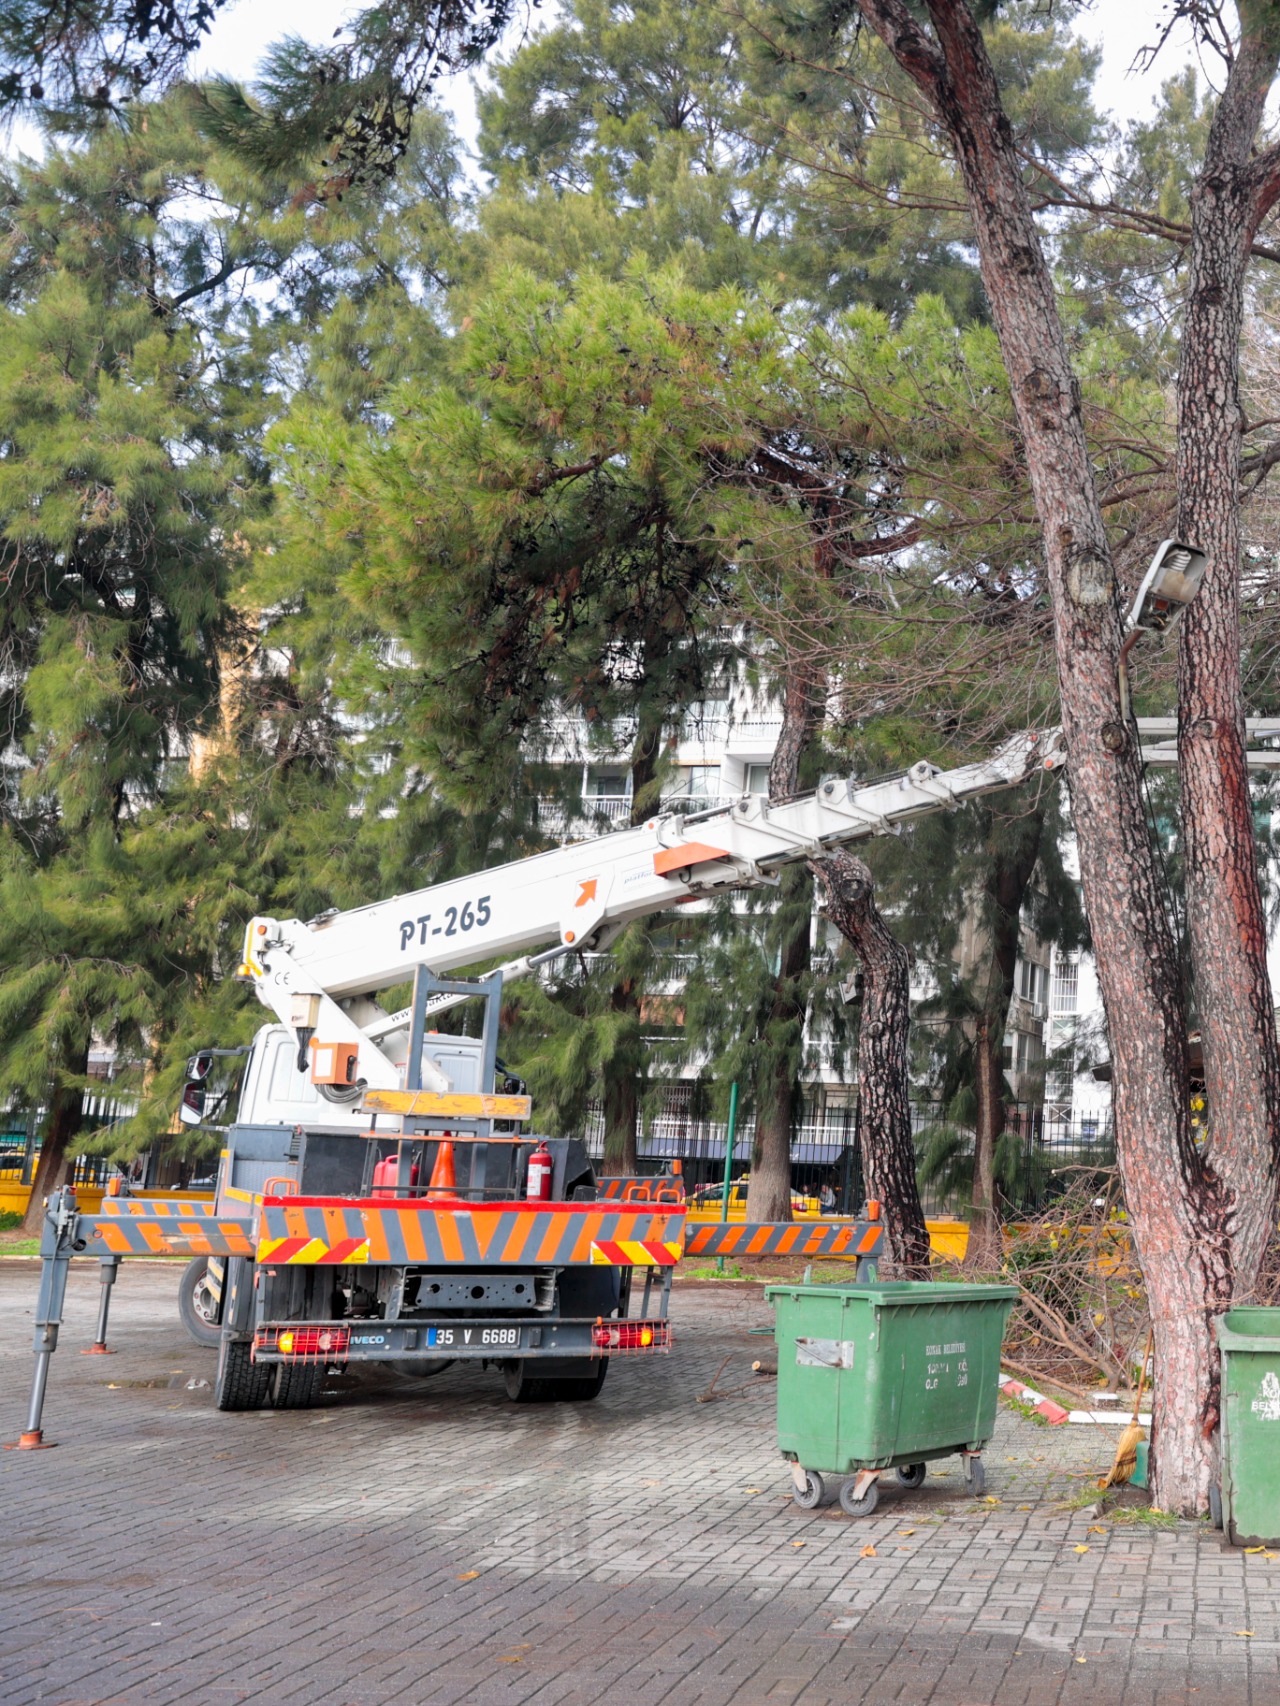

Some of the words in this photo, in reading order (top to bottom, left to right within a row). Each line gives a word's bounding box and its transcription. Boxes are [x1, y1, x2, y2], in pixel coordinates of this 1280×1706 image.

[400, 895, 491, 951] PT-265
[275, 972, 290, 985] CE
[350, 1335, 385, 1345] IVECO
[436, 1329, 454, 1344] 35
[464, 1329, 472, 1344] V
[482, 1328, 516, 1344] 6688
